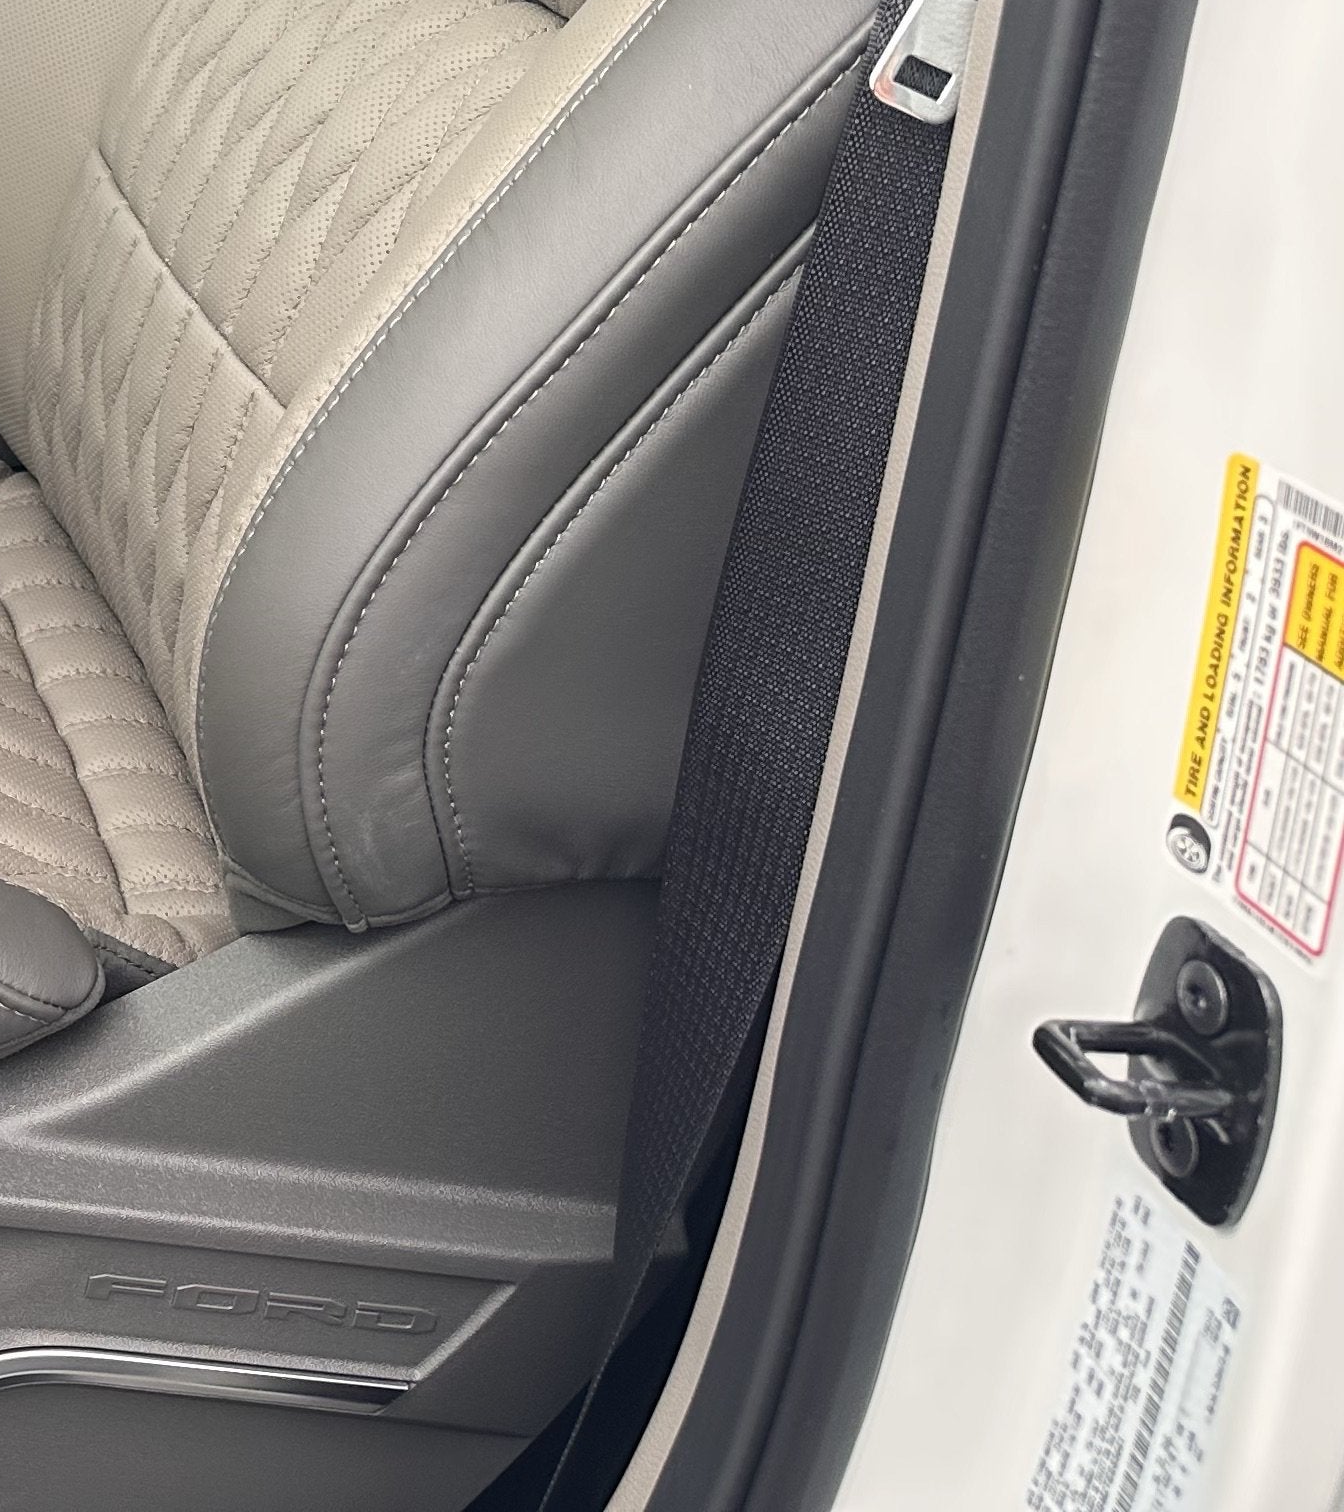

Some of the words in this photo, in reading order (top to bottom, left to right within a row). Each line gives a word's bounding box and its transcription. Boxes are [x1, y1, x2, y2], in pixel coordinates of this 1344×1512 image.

[1184, 751, 1204, 797] TIRE
[1194, 706, 1211, 750] AND
[1203, 612, 1229, 703] LOADING
[1220, 463, 1252, 608] INFORMATION
[1263, 623, 1277, 645] kg
[84, 1272, 438, 1335] FORD
